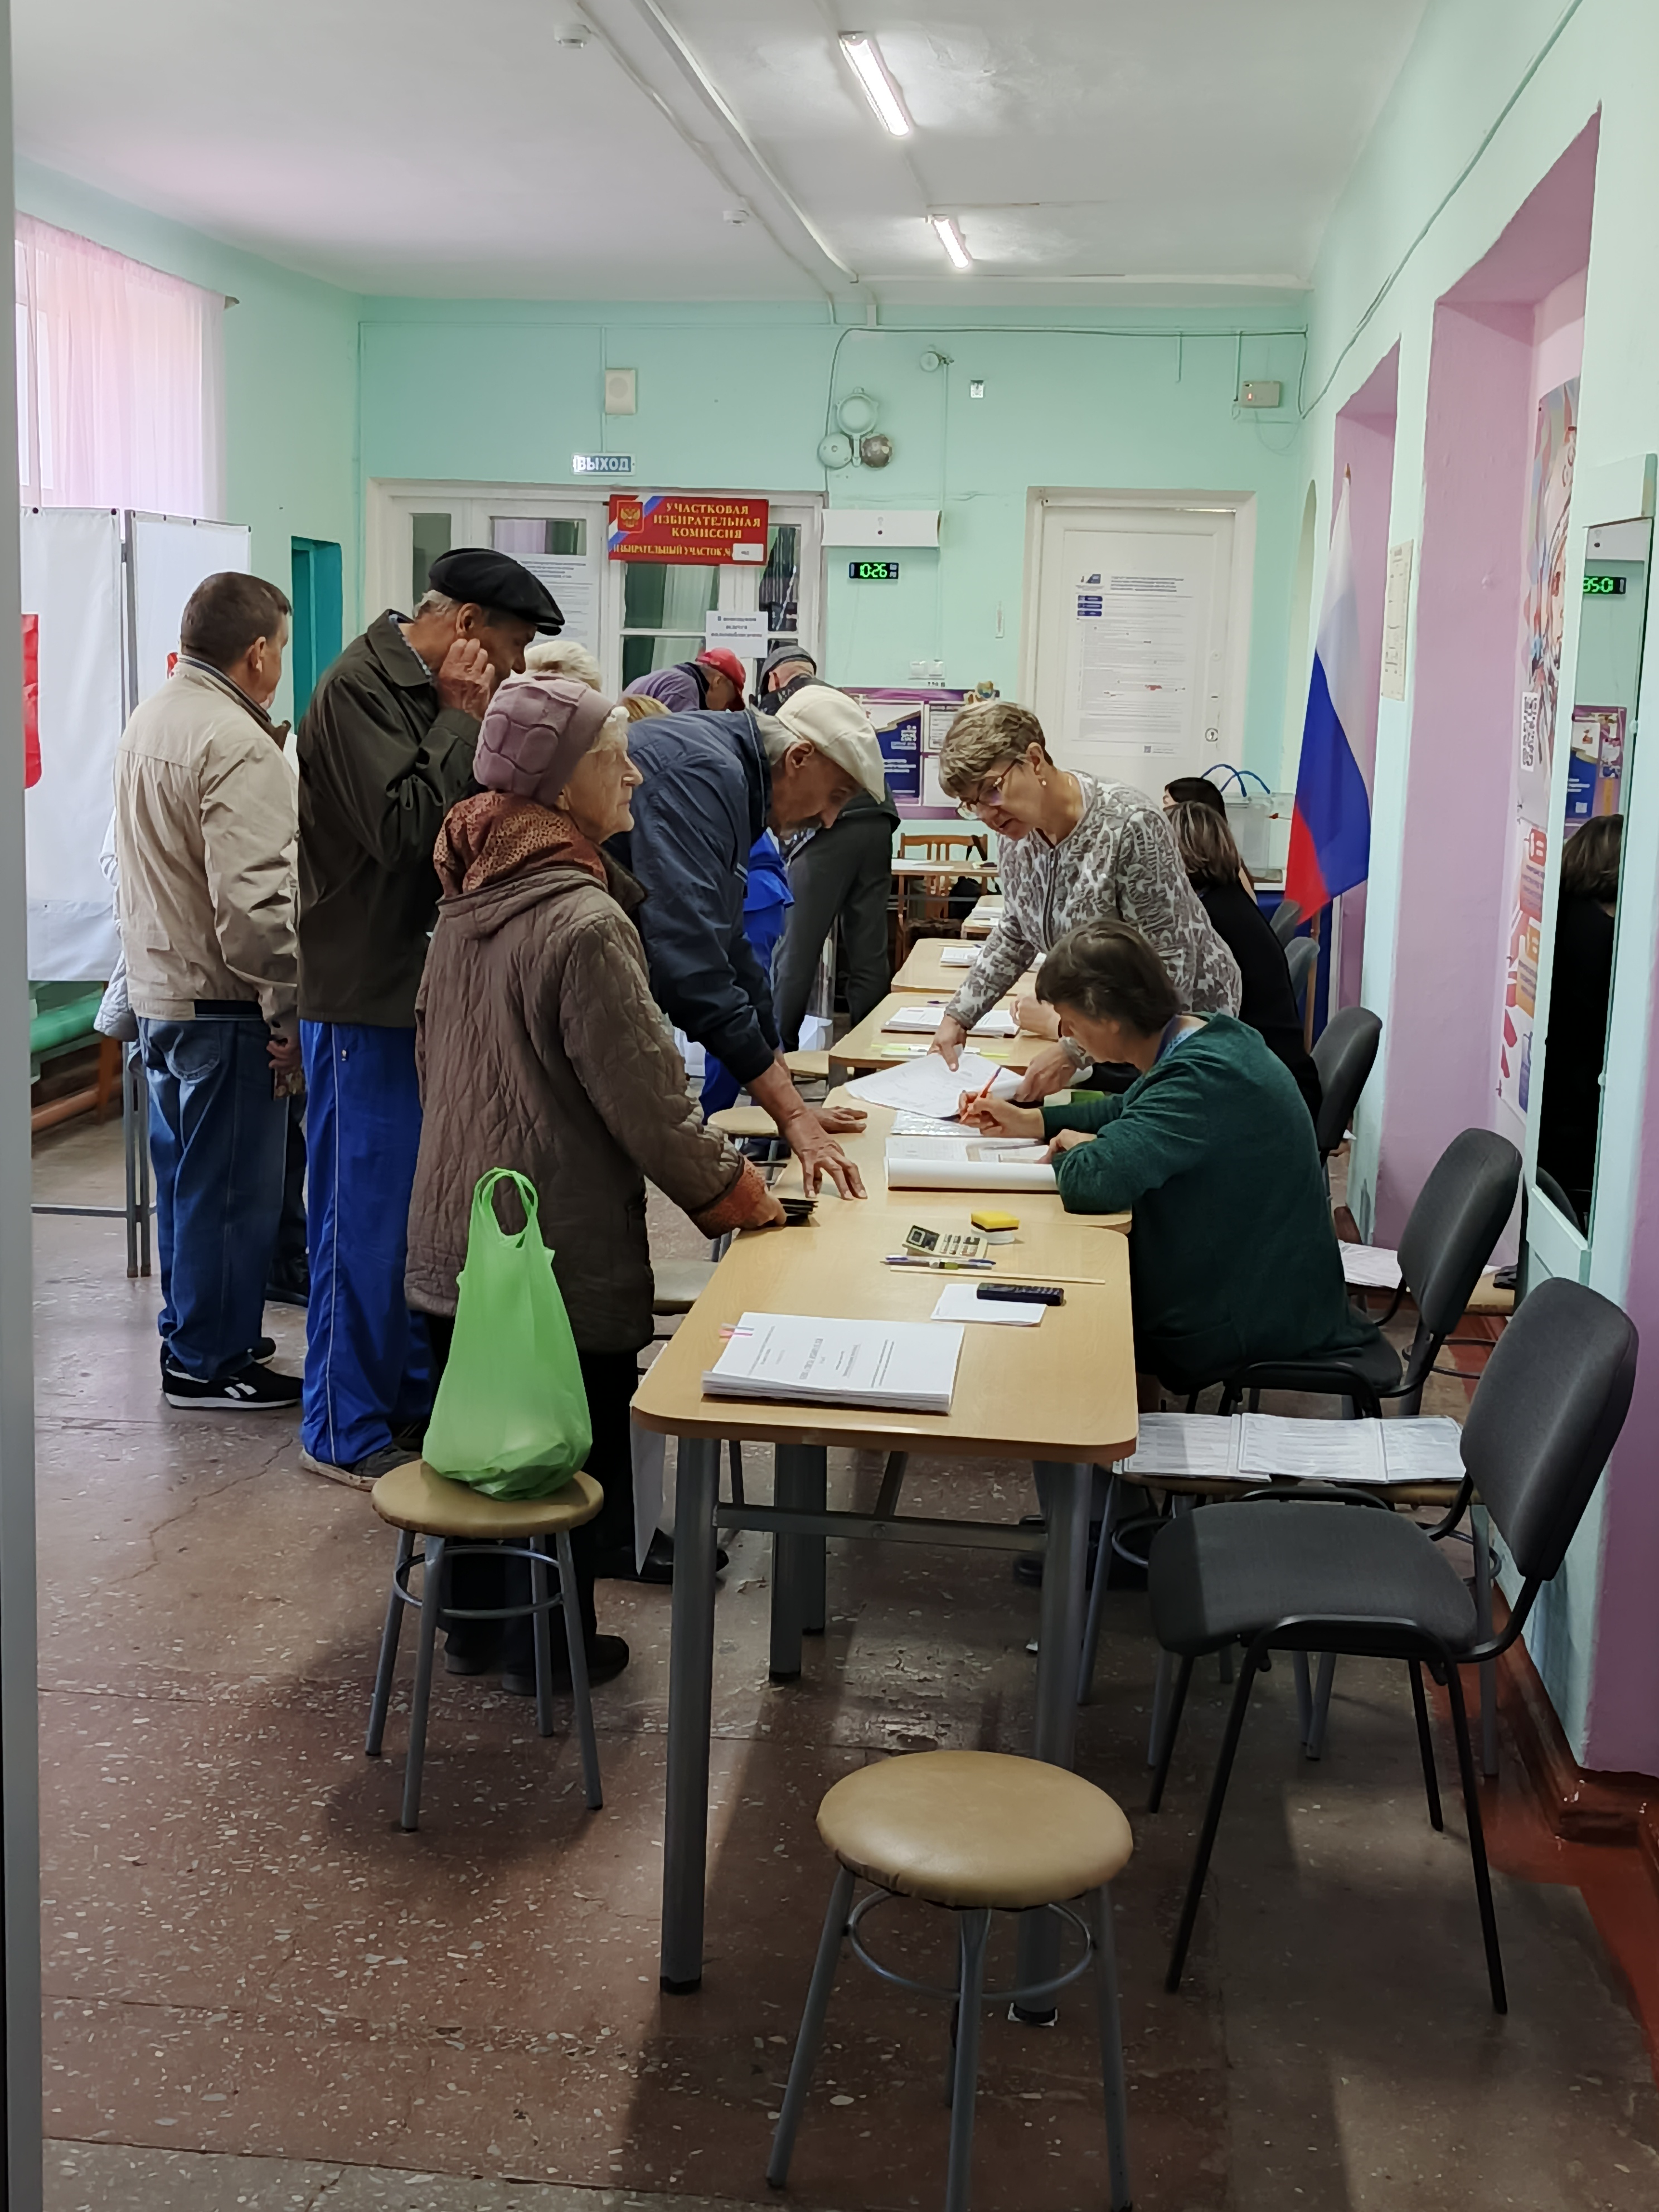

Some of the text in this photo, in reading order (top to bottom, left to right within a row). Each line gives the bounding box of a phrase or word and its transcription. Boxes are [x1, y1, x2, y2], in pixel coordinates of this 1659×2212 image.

[577, 457, 629, 471] ВЫХОД
[666, 503, 749, 515] УЧАСТКОВАЯ
[653, 515, 760, 527] ИЗБИРАТЕЛЬНАЯ
[672, 527, 742, 539] КОМИССИЯ
[613, 544, 682, 555] ИЗБИРАТЕЛЬНЫЙ
[684, 546, 722, 556] УЧАСТОК
[860, 564, 887, 578] 10:26
